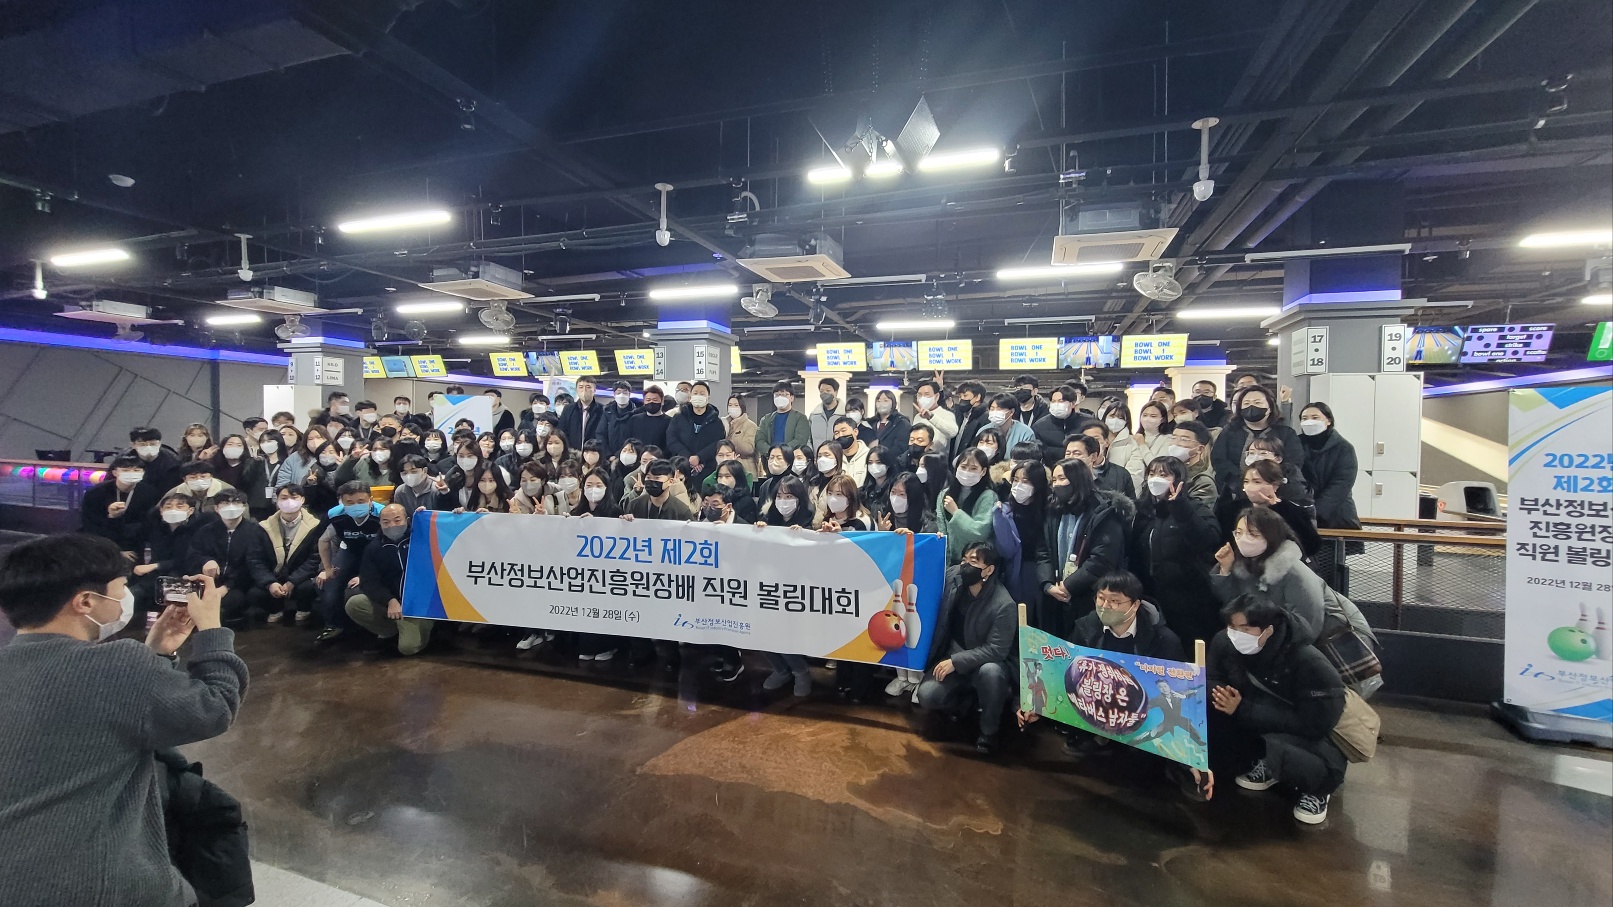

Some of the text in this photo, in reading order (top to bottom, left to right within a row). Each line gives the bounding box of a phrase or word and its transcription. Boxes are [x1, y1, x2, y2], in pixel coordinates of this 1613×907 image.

[1310, 334, 1324, 344] 17
[1387, 332, 1402, 342] 19
[1310, 358, 1324, 366] 18
[1386, 356, 1402, 366] 20
[576, 534, 720, 568] 2022년 제2회
[1516, 542, 1612, 568] 직원 볼링
[466, 560, 860, 618] 부산정보산업진흥원장배 직원 볼링대회
[1526, 576, 1566, 589] 2022년
[1568, 580, 1593, 592] 12월
[549, 604, 640, 623] 2022년 12월 28일 (수)
[695, 617, 751, 630] 부산정보산업진흥원
[1082, 678, 1129, 706] 볼링장 온
